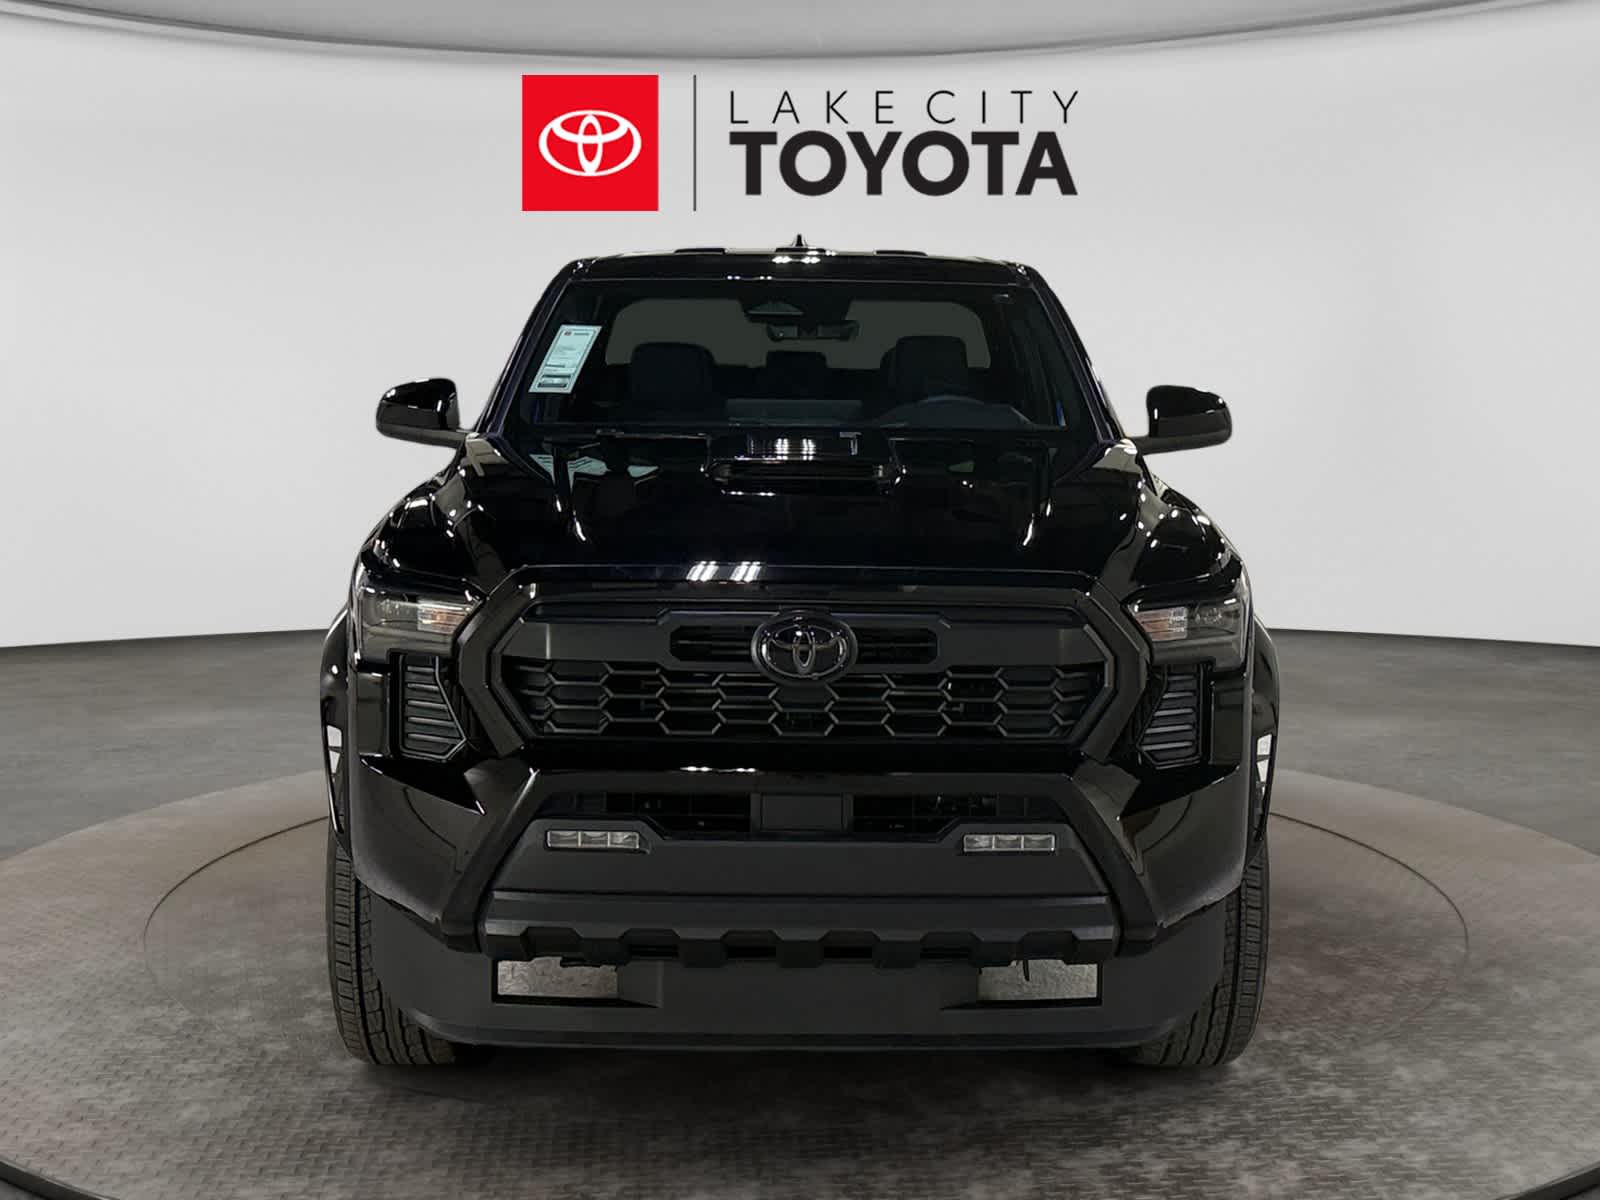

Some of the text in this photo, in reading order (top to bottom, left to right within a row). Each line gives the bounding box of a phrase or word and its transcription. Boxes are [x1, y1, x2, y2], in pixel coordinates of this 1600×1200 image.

[730, 90, 1079, 125] LAKE CITY
[728, 130, 1078, 196] TOYOTA
